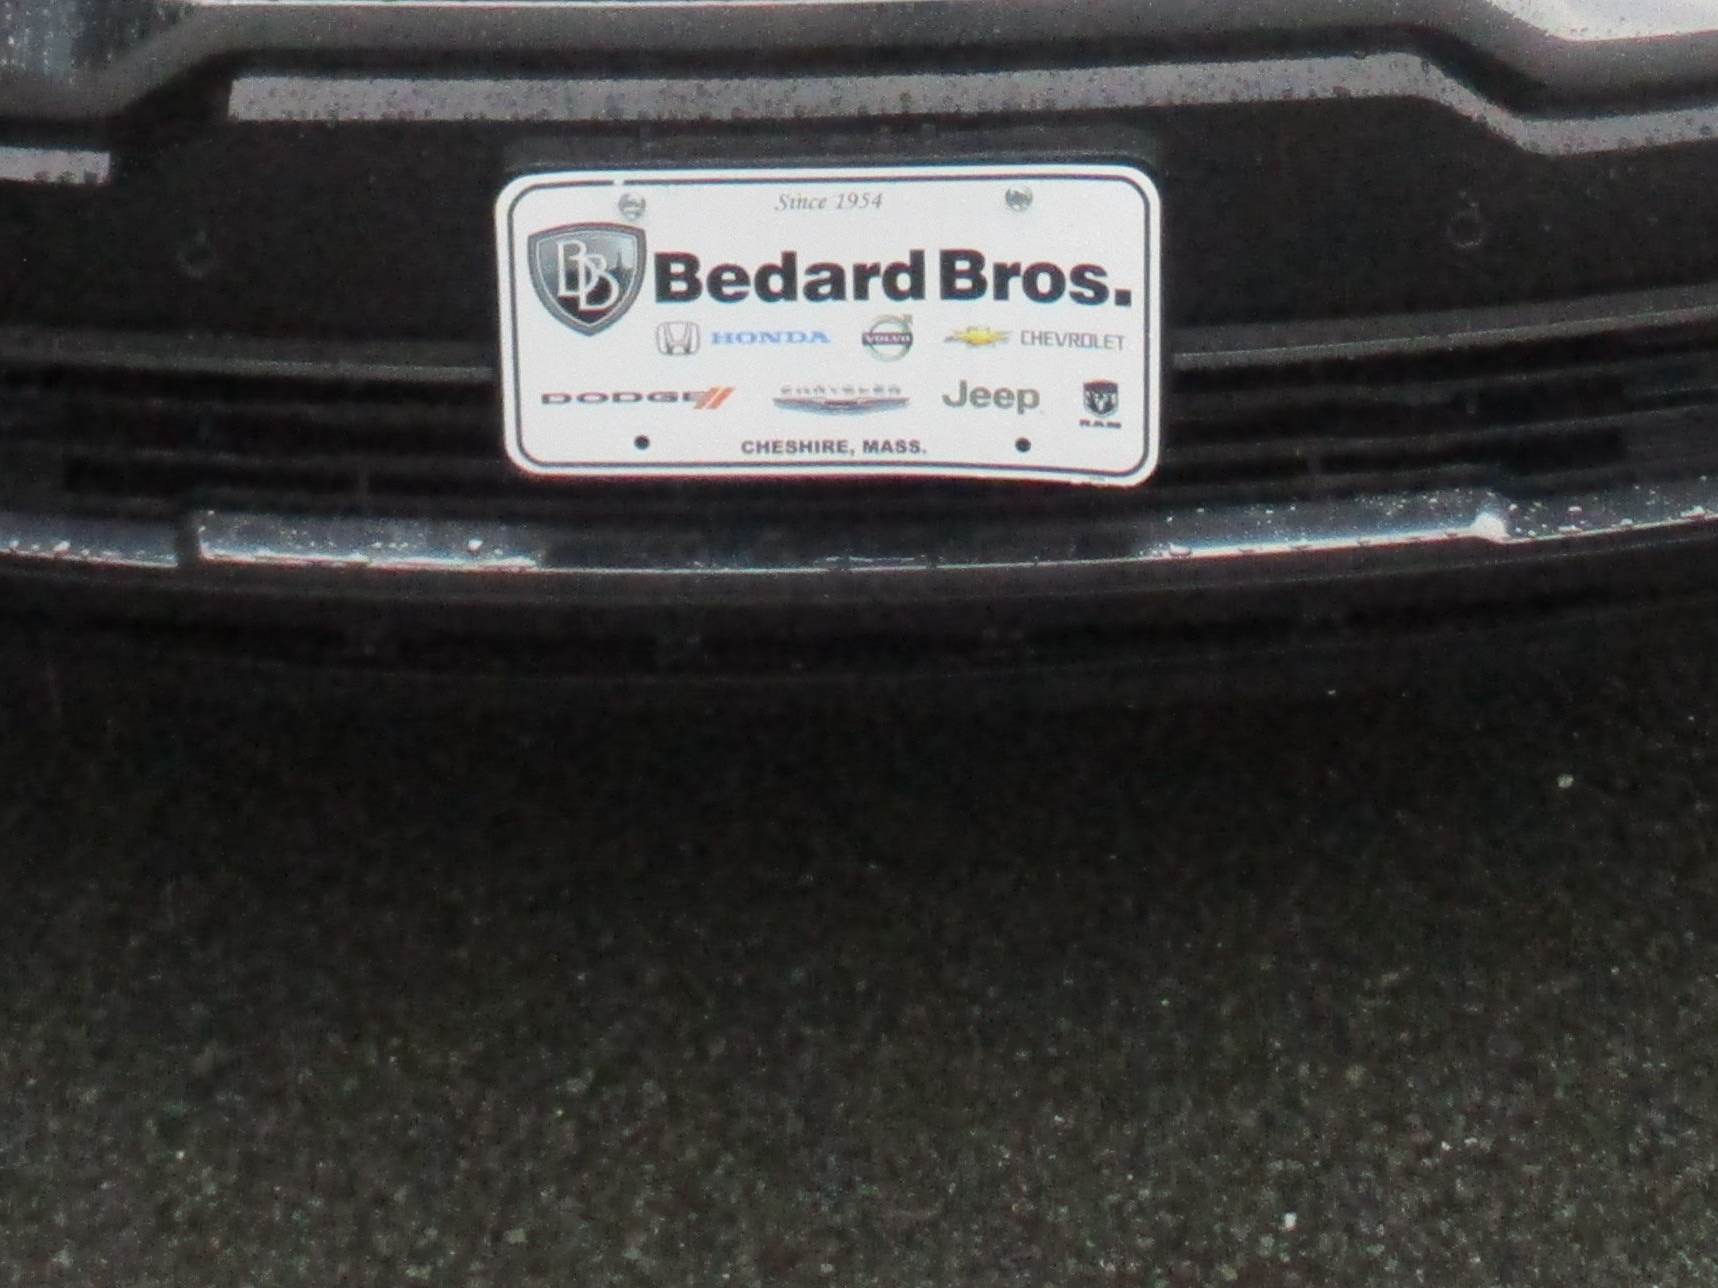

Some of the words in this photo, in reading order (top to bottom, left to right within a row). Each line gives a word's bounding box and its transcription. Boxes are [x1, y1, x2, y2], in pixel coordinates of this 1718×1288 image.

[774, 192, 827, 211] Since
[836, 192, 883, 210] 1954
[654, 250, 926, 304] Bedard
[939, 249, 1133, 307] Bros.
[711, 331, 831, 345] HONDA
[1020, 329, 1125, 350] CHEVROLET
[942, 379, 1040, 415] Jeep
[741, 439, 856, 456] CHESHIRE,
[862, 439, 928, 454] MASS.
